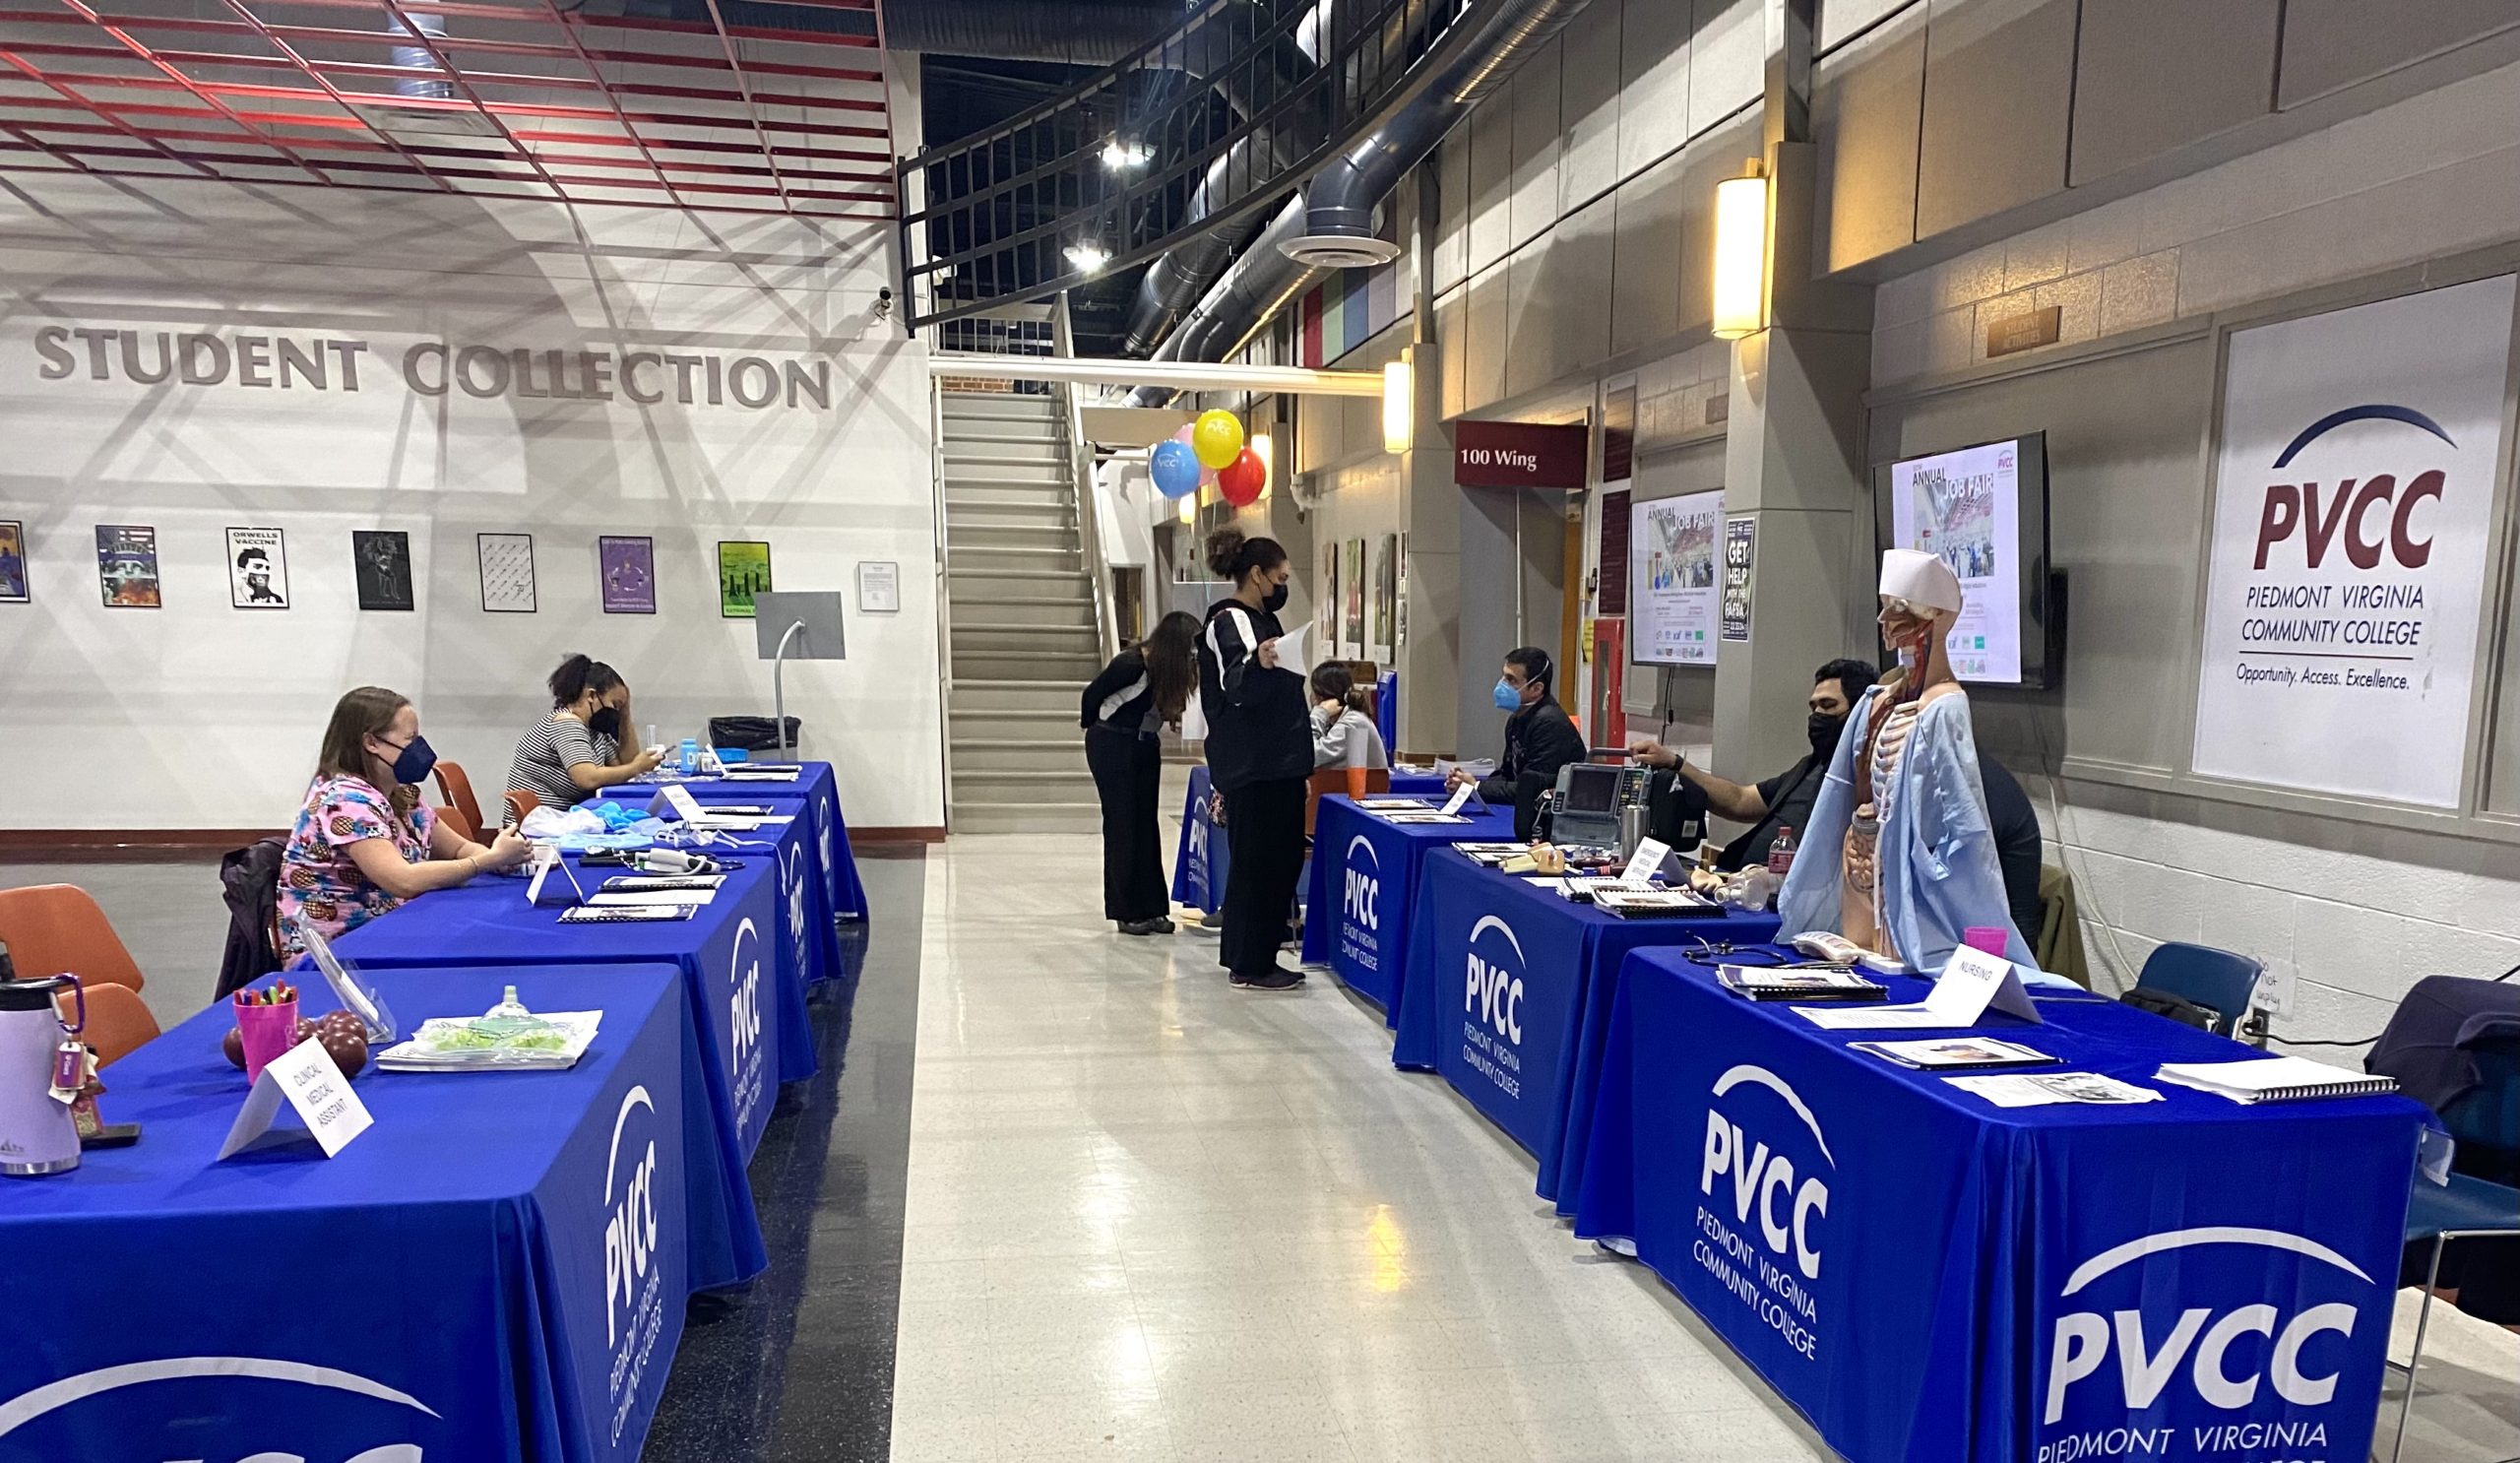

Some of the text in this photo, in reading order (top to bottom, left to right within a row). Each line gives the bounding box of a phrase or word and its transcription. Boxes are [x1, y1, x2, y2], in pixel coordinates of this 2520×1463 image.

[34, 325, 832, 411] STUDENT COLLECTION
[1461, 448, 1538, 473] 100 Wing
[1913, 467, 1947, 487] ANNUAL
[1944, 473, 1993, 499] JOB FAIR
[1647, 506, 1675, 521] ANNUAL
[1673, 511, 1715, 531] JOB FAIR
[2253, 470, 2447, 571] PVCC
[1728, 541, 1748, 564] GET
[1728, 567, 1747, 585] HELP
[1725, 602, 1744, 616] FAFSA
[2246, 584, 2425, 609] PIEDMONT VIRGINIA
[2241, 618, 2422, 646] COMMUNITY COLLEGE
[2236, 663, 2411, 690] Opportunity. Access. Excellence.
[1345, 867, 1378, 930] PVCC
[1960, 960, 1993, 982] NURSING
[1465, 952, 1525, 1047] PVCC
[730, 960, 761, 1077] PVCC
[1464, 1021, 1521, 1075] PIEDMONT VIRGINIA
[292, 1062, 322, 1087] CLINICAL
[1463, 1044, 1521, 1101] COMMUNITY COLLEGE
[305, 1081, 335, 1106] MEDICAL
[316, 1098, 347, 1128] ASSISTANT
[1701, 1108, 1829, 1280] PVCC
[604, 1139, 658, 1351] PVCC
[1696, 1205, 1817, 1325] PIEDMONT VIRGINIA
[1693, 1239, 1817, 1362] COMMUNITY COLLEGE
[609, 1262, 662, 1405] PIEDMONT VIRGINIA
[642, 1297, 663, 1367] COLLEGE
[2044, 1303, 2359, 1426] PVCC
[2038, 1422, 2328, 1463] PIEDMONT VIRGINIA
